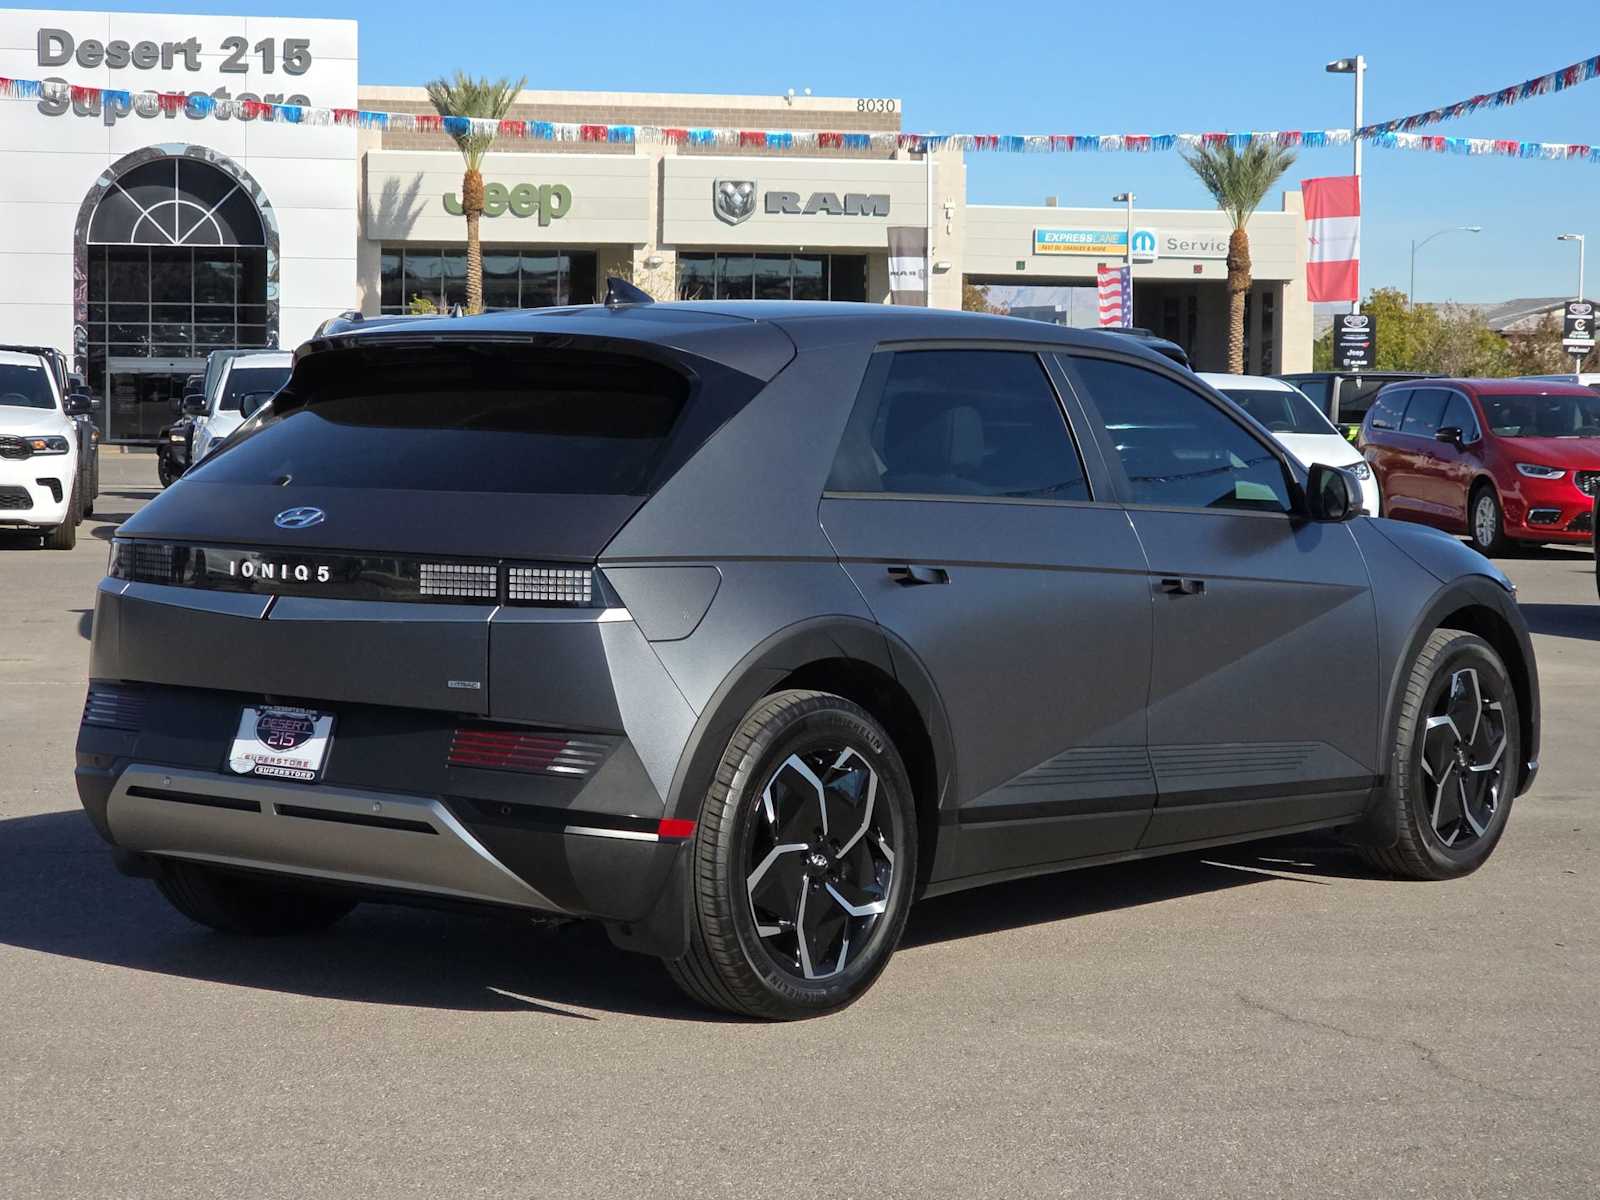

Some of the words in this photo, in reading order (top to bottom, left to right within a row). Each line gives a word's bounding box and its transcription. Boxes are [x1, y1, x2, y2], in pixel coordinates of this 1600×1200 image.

[37, 28, 202, 71] Desert
[219, 36, 312, 76] 215
[856, 98, 896, 113] 8030
[764, 190, 891, 217] RAM
[1168, 238, 1226, 251] Servic
[229, 560, 309, 581] IONIQ
[317, 565, 330, 582] 5
[261, 718, 310, 731] DESERT
[267, 731, 295, 746] 215
[258, 765, 312, 779] SUPERSTORE
